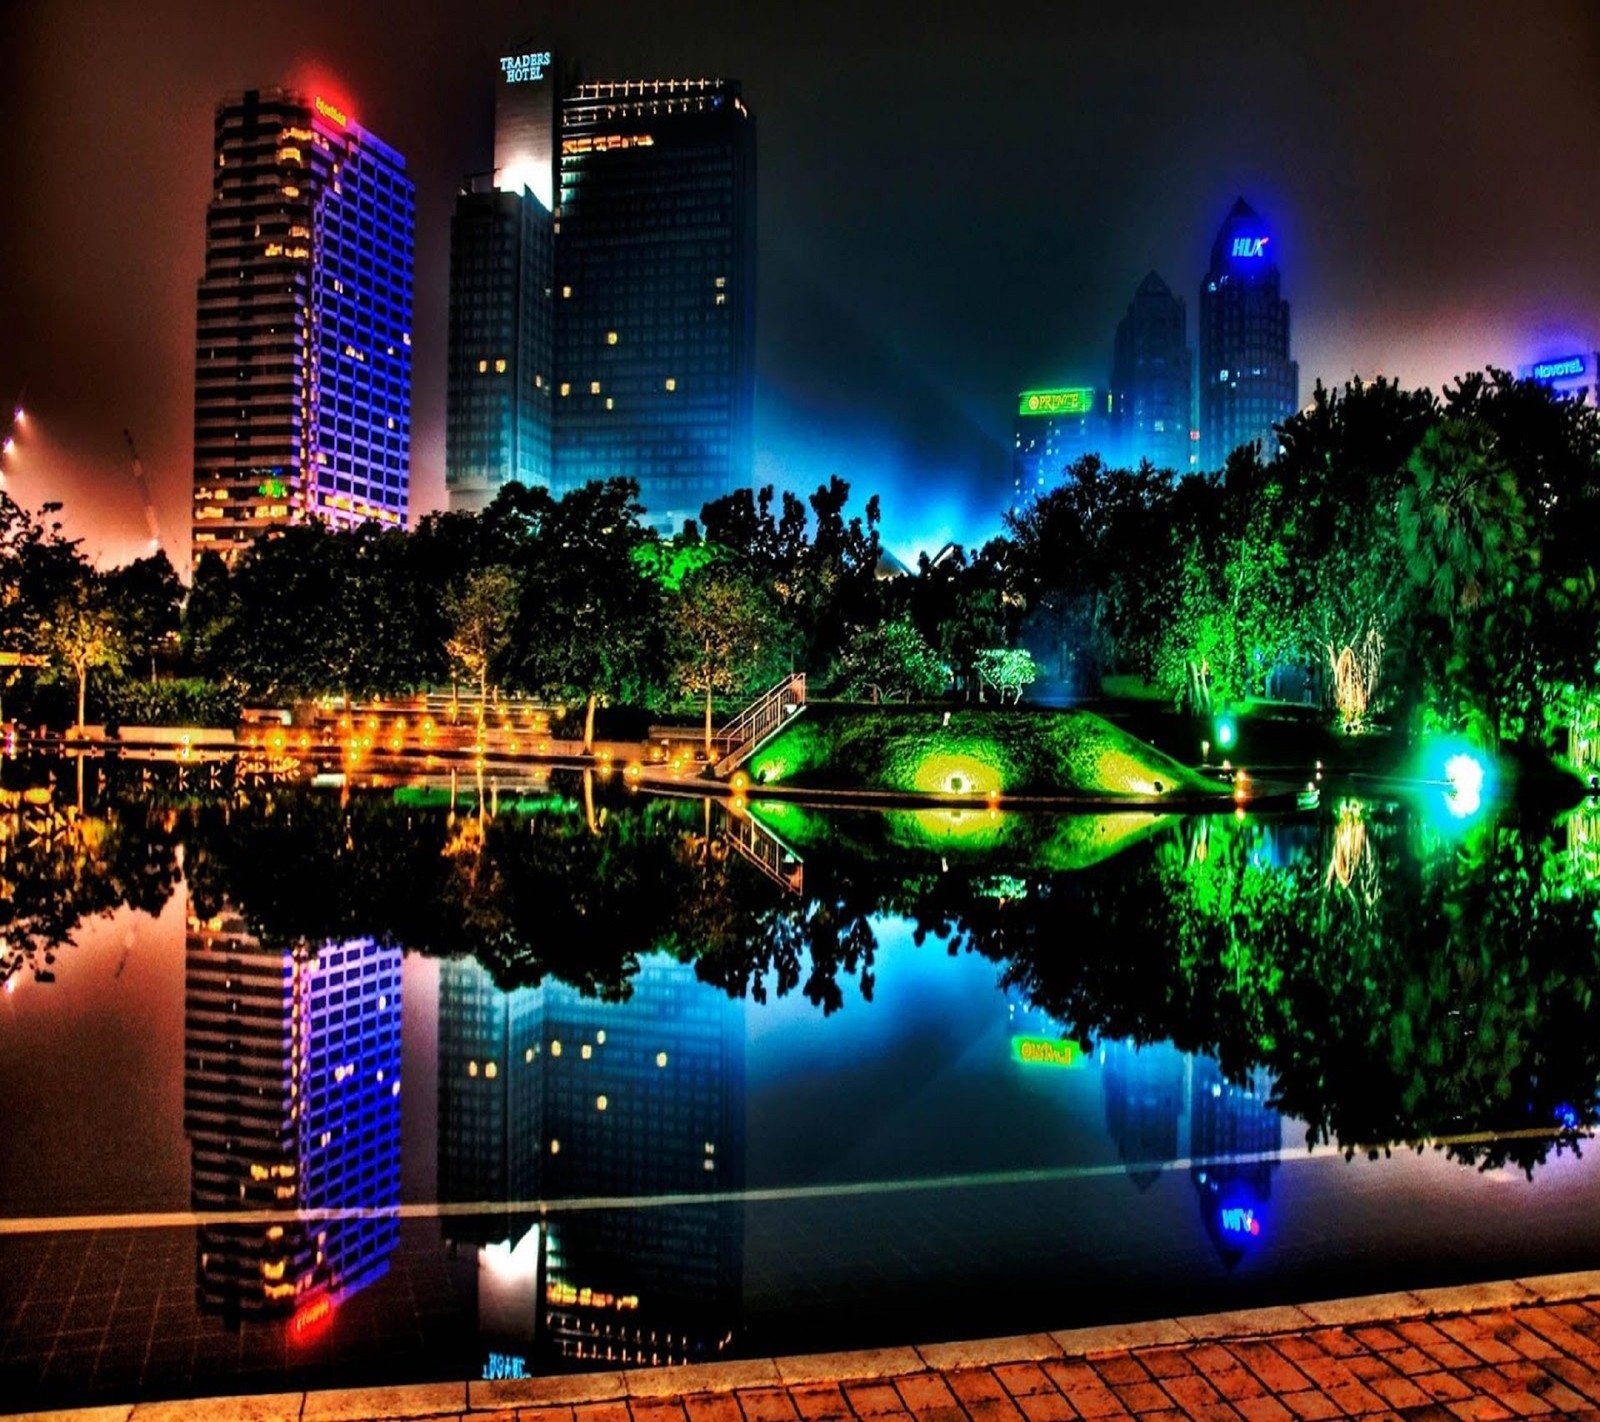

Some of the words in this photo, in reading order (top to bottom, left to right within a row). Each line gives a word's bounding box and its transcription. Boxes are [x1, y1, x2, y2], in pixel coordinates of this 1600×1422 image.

[500, 51, 551, 70] TRADERS
[506, 67, 544, 83] HOTEL
[1534, 358, 1584, 379] NOVOTEL
